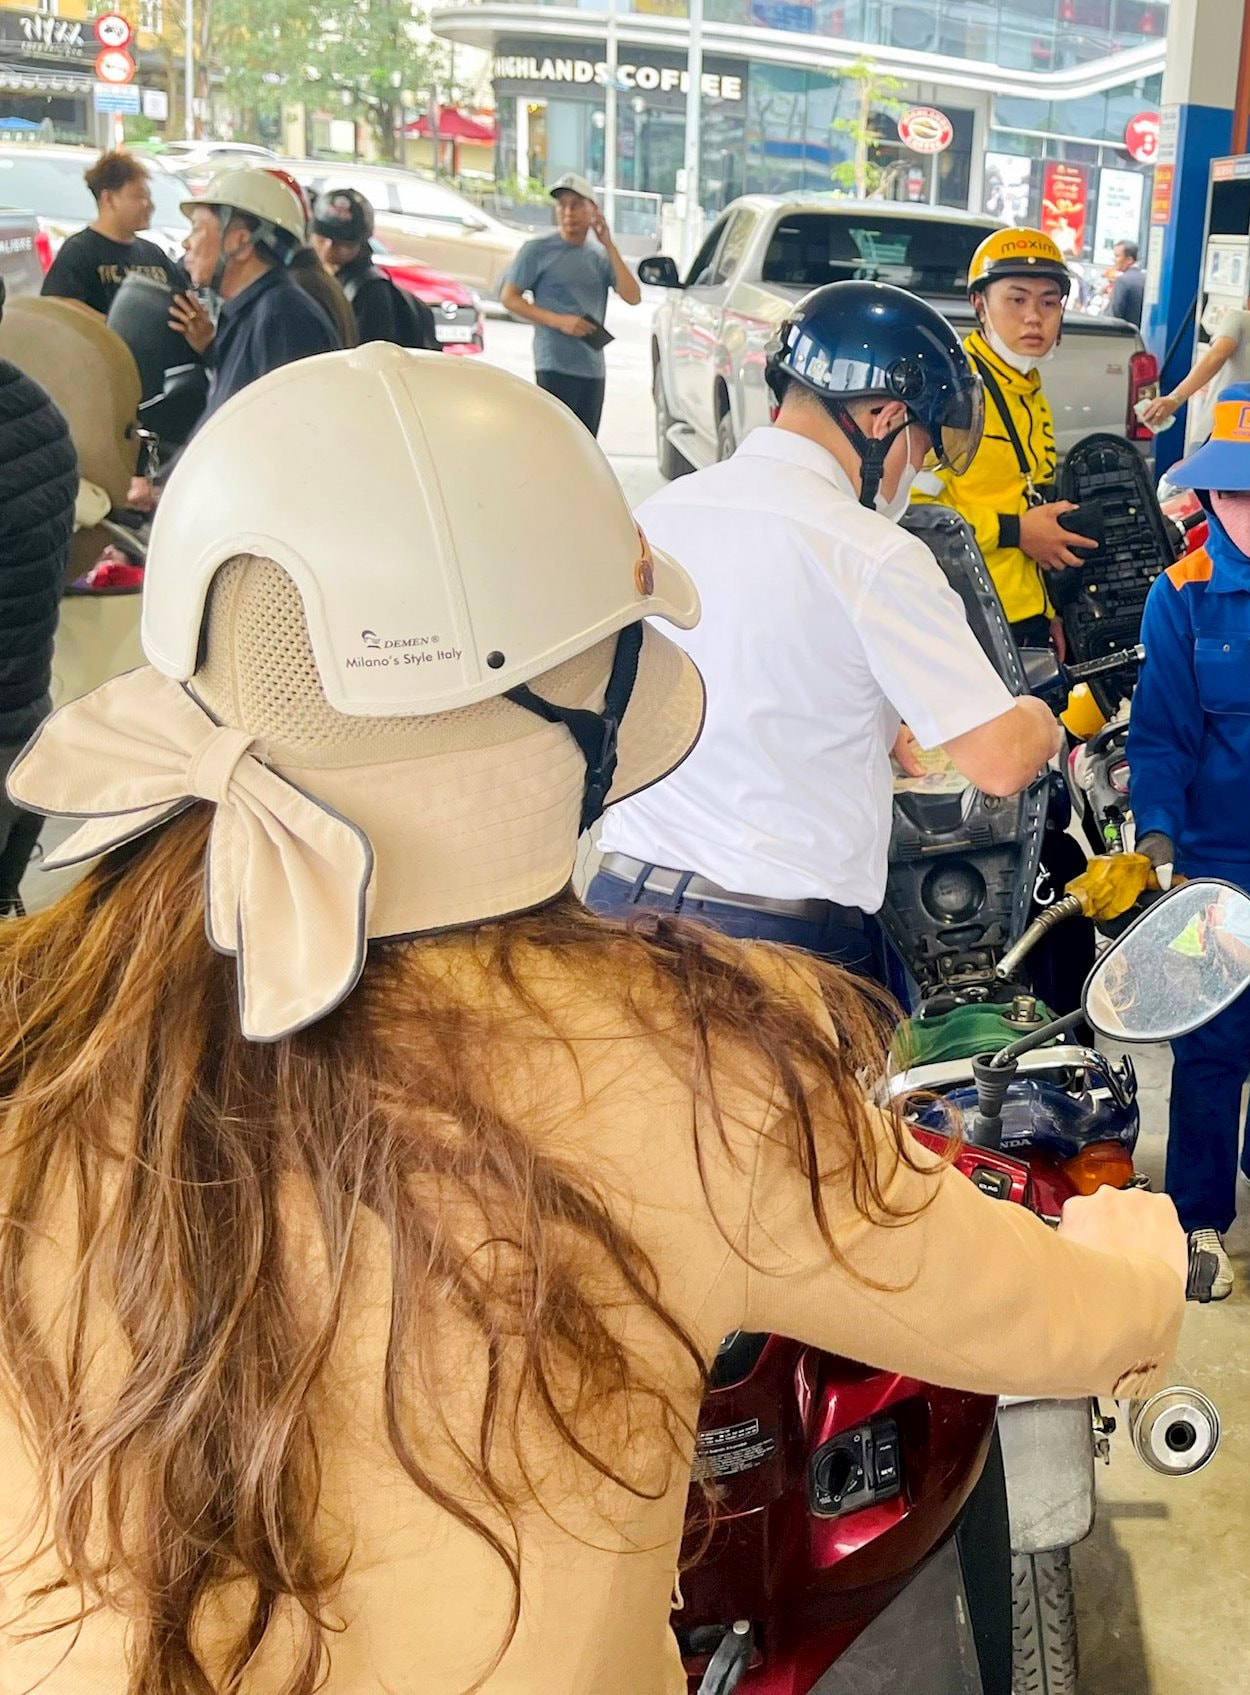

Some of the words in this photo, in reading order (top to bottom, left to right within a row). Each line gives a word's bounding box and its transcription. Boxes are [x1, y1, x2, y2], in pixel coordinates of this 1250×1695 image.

[1001, 238, 1056, 257] maxim
[346, 655, 399, 668] Milano's
[403, 652, 433, 665] Style
[437, 647, 462, 660] Italy
